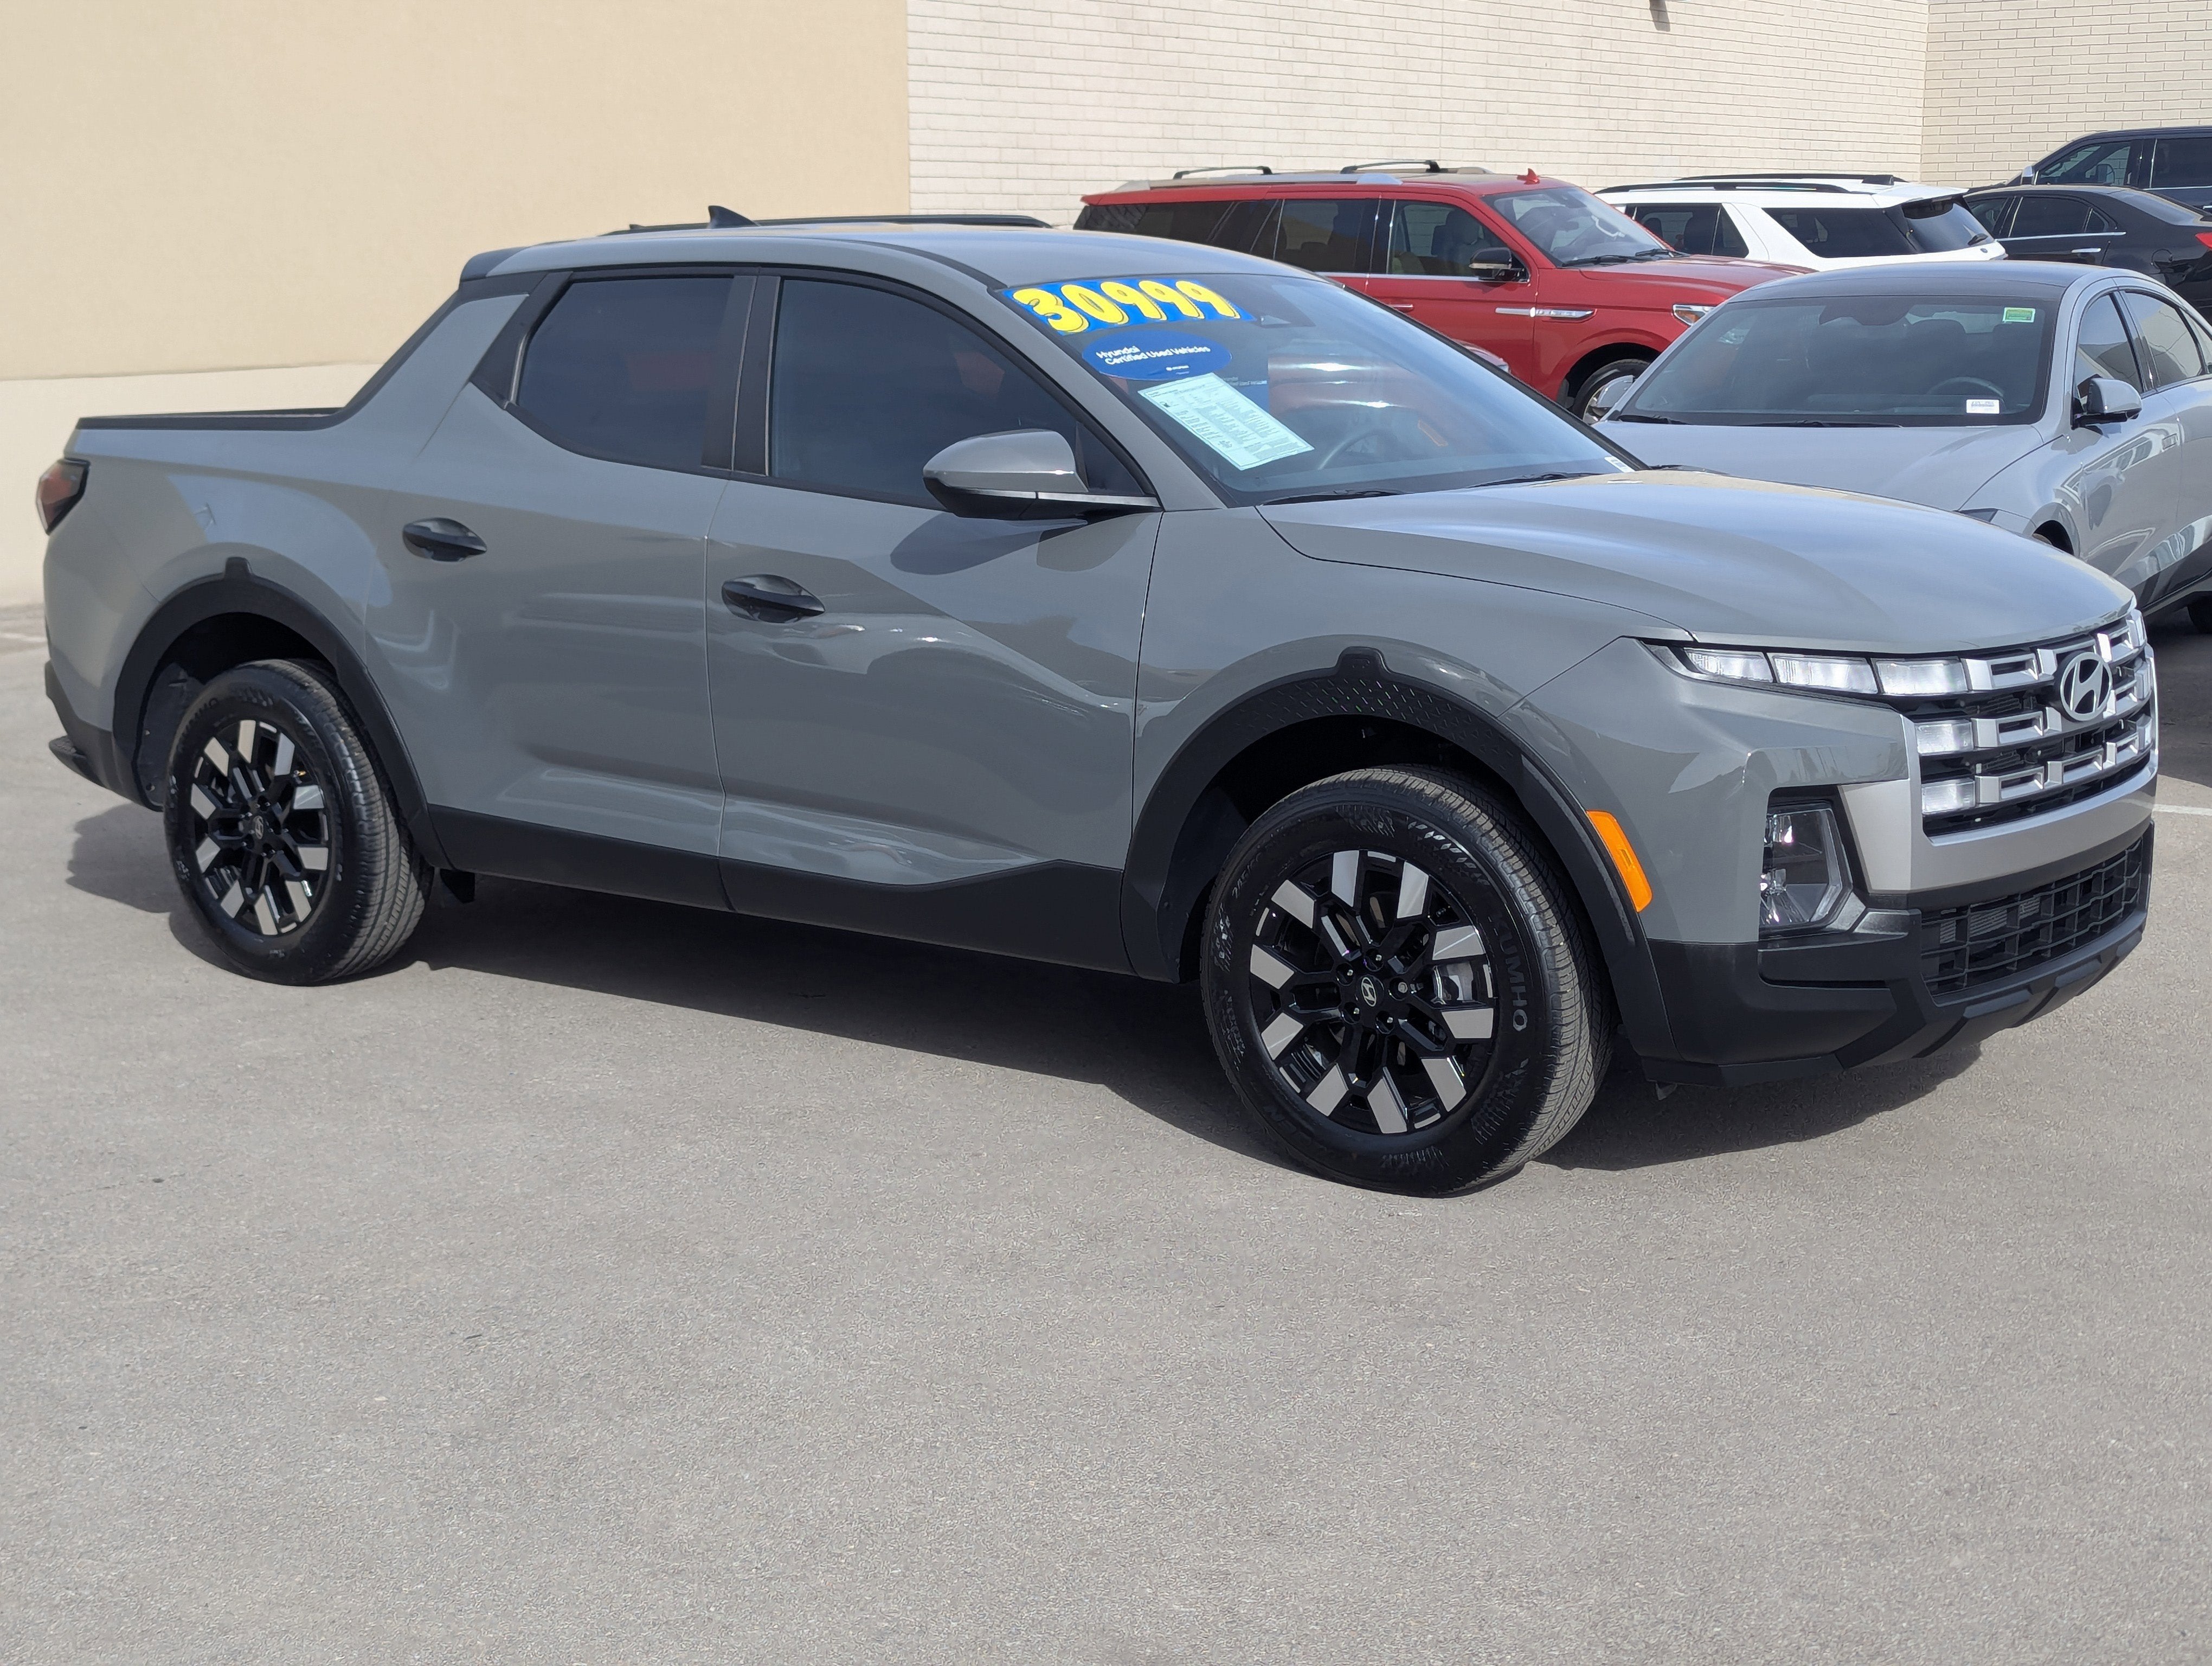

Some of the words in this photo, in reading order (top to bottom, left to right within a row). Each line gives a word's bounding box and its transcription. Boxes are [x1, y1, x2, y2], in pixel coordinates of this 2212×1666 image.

[1012, 280, 1241, 333] 30999
[1096, 345, 1140, 358] Hyundai
[1104, 352, 1149, 365] Certified
[1146, 349, 1173, 357] Used
[1170, 346, 1211, 355] Vehicles
